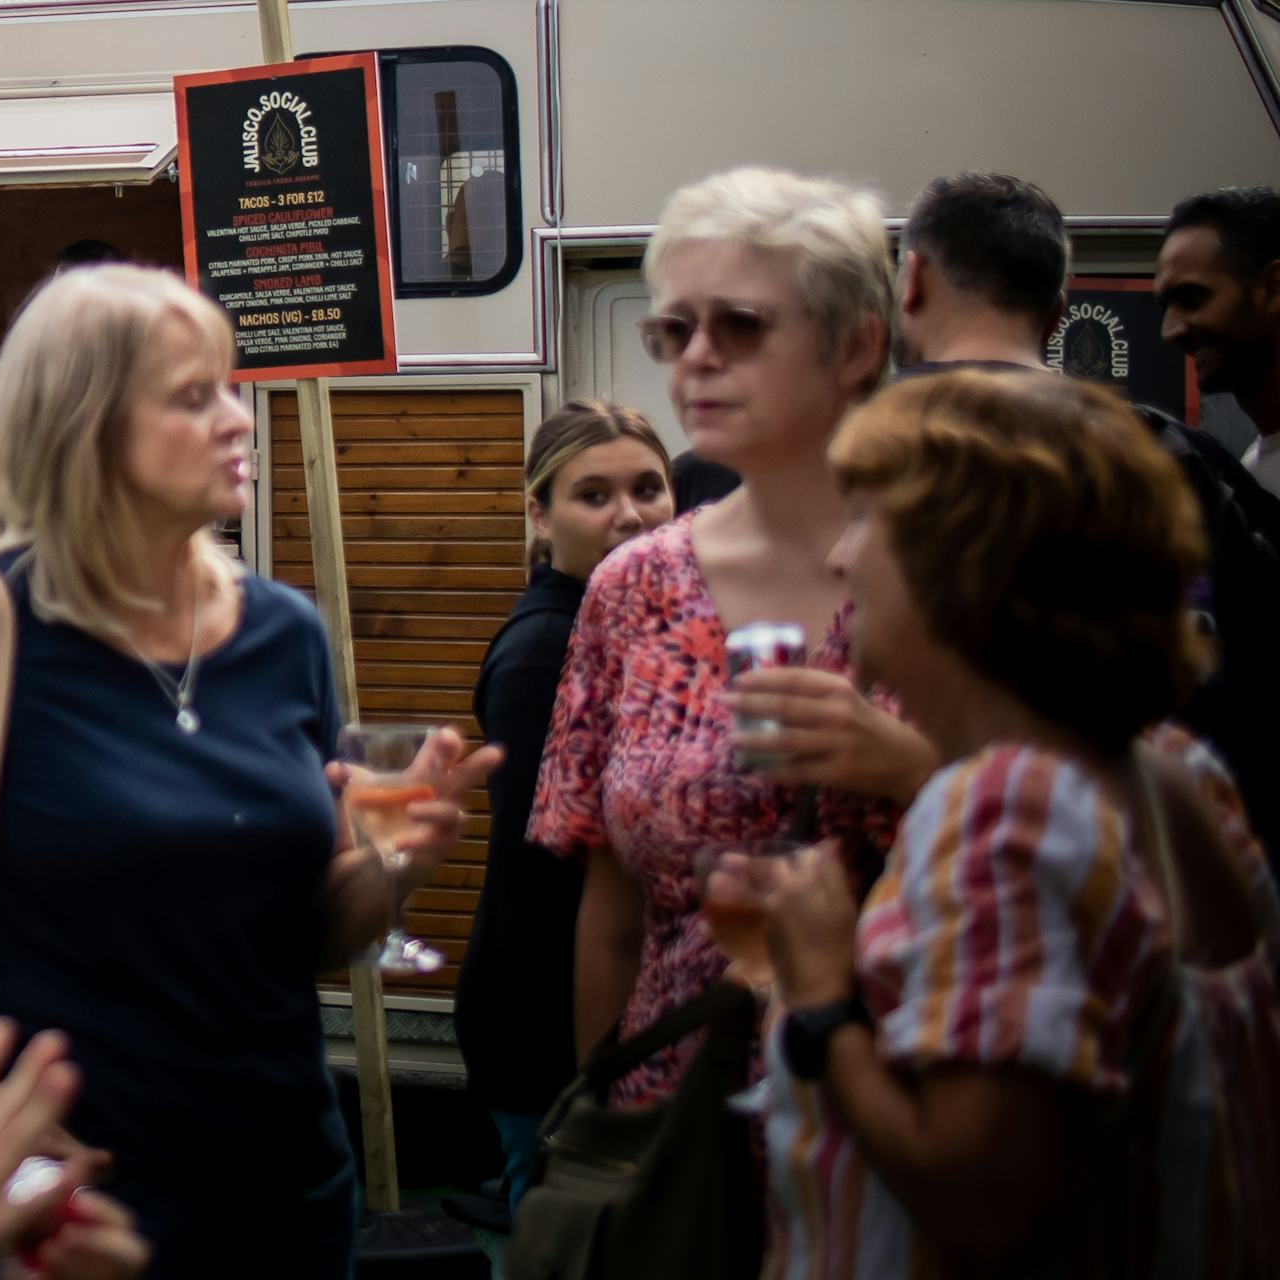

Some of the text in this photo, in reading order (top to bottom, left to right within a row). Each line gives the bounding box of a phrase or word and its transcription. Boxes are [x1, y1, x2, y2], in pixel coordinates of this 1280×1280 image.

[239, 196, 270, 209] TACOS
[278, 195, 284, 205] 3
[287, 193, 305, 205] FOR
[307, 191, 324, 203] £12
[233, 207, 333, 226] SPICED CAULIFLOWER
[252, 278, 293, 290] SMOKED
[239, 313, 279, 326] NACHOS
[281, 310, 302, 325] (VG)
[311, 308, 340, 321] £8.50
